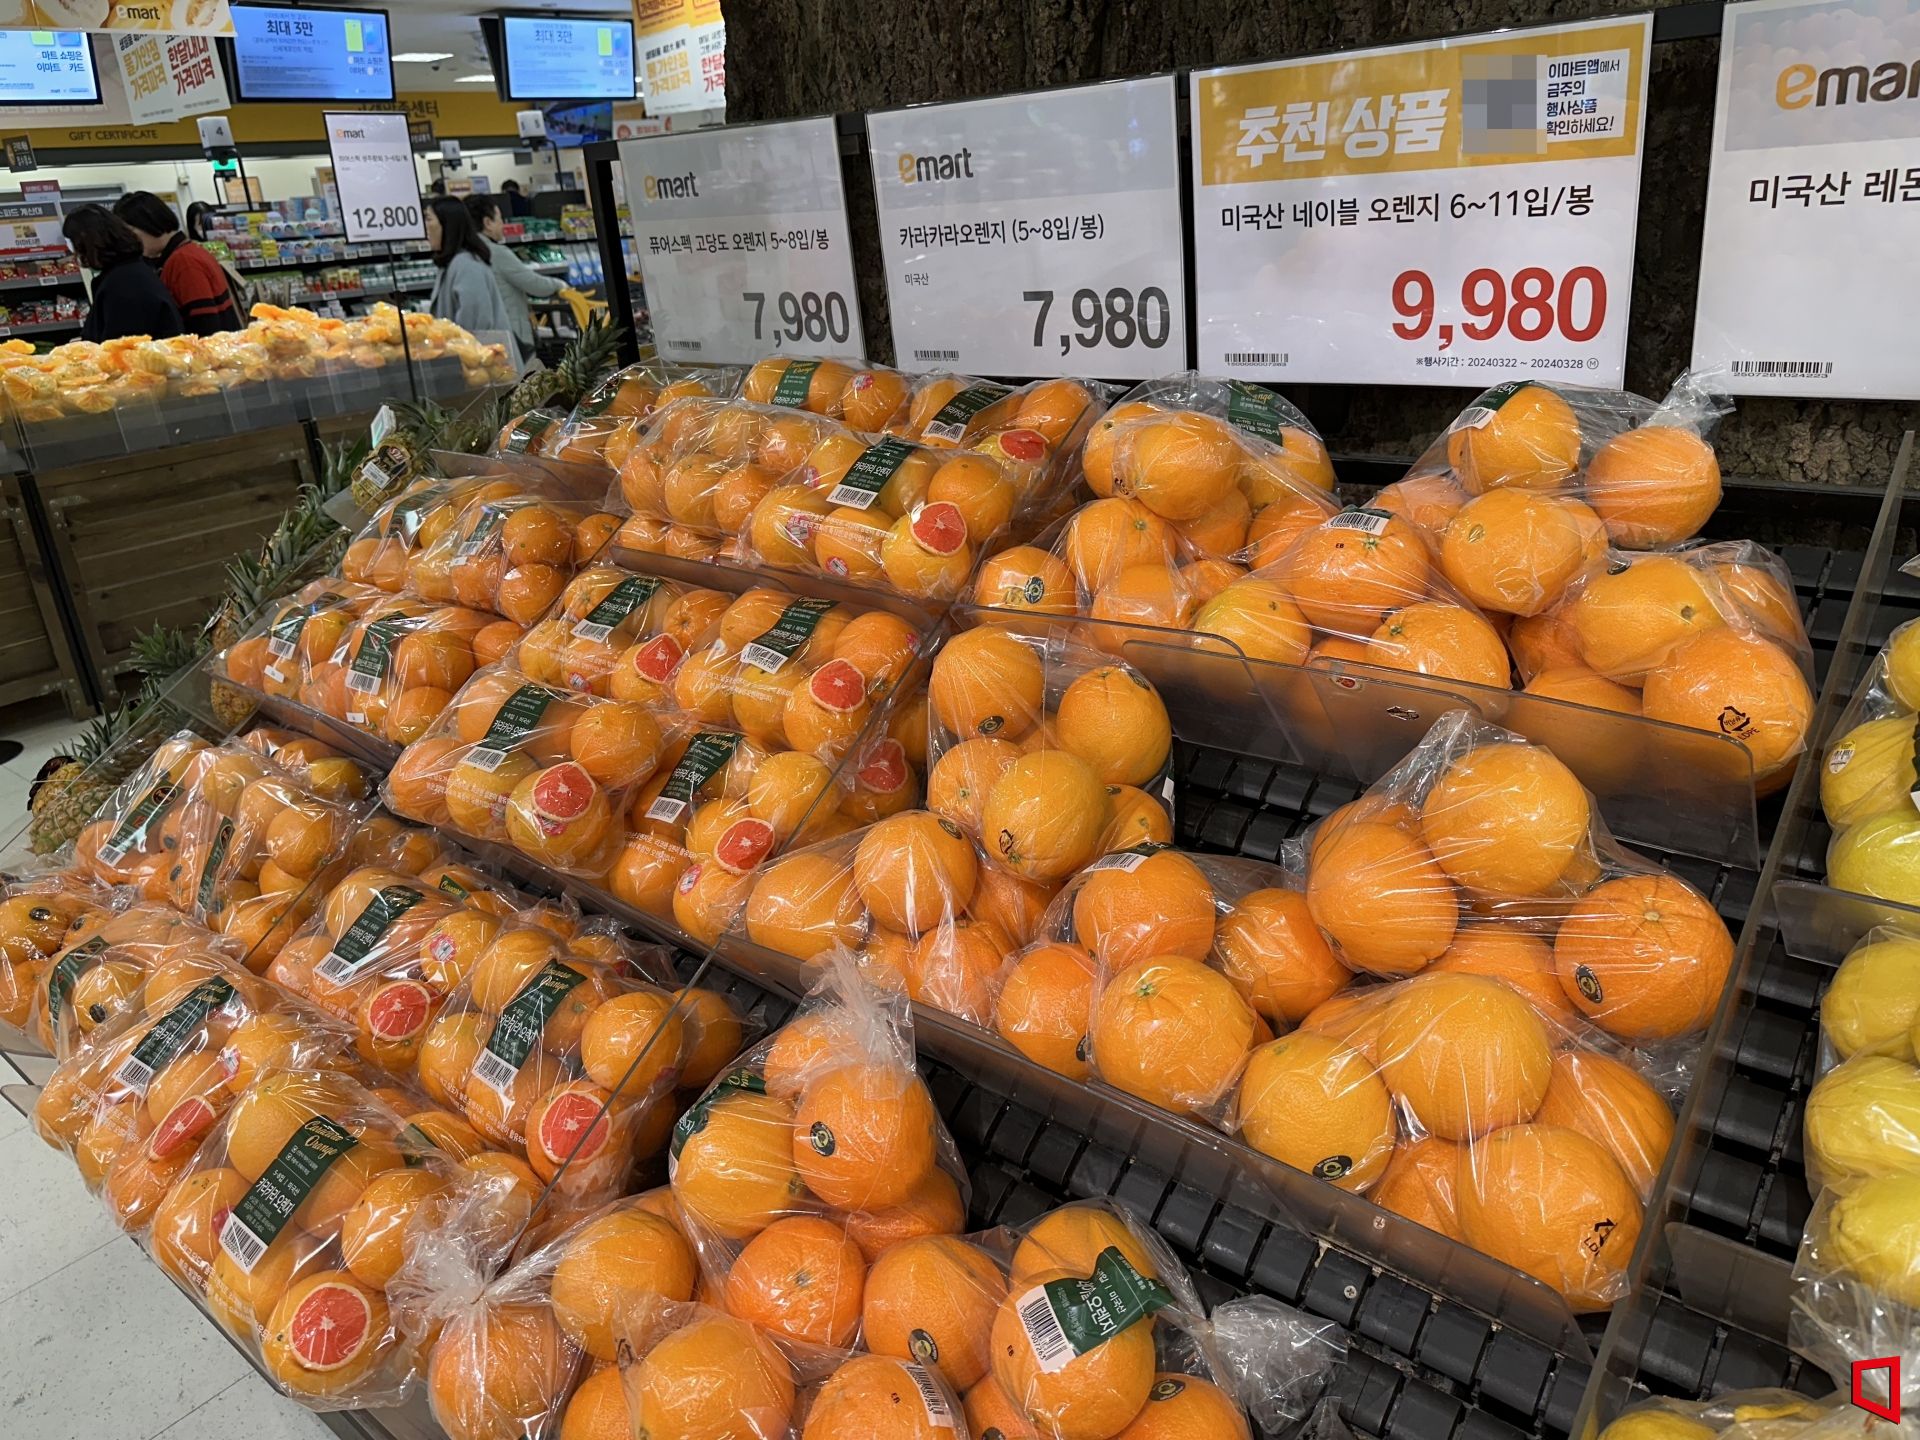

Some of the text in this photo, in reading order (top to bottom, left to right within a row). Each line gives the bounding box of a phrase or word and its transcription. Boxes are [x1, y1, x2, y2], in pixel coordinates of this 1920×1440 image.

[267, 20, 314, 37] 최대 3만
[36, 62, 85, 72] 이마트 카드
[173, 55, 216, 96] 가격파격
[1548, 58, 1621, 79] 이마트앱에서
[130, 62, 168, 101] 가격파격
[1547, 79, 1586, 98] 금주의
[1546, 98, 1598, 118] 행사상품
[69, 129, 159, 141] GIFT CERTIFICATE
[215, 126, 224, 136] 4
[336, 129, 365, 139] emart
[1237, 88, 1450, 168] 추천 상품
[1545, 116, 1614, 136] 확인하세요!
[899, 147, 974, 184] emart
[644, 171, 699, 199] emart
[1749, 170, 1852, 209] 미국산
[352, 206, 419, 231] 12,800
[1222, 184, 1595, 232] 미국산 네이블 오렌지 6~11입/봉
[649, 228, 830, 255] 퓨어스펙 고당도 오렌지 5~8입/봉
[900, 213, 1106, 248] 카라카라오렌지 (5~8입/봉)
[904, 272, 929, 286] 미국산
[743, 291, 850, 348] 7,980
[1023, 286, 1171, 356] 7,980
[1391, 265, 1608, 351] 9,980
[1467, 358, 1518, 369] 20240322
[1530, 358, 1584, 369] 20240328
[304, 1135, 338, 1159] Orange
[256, 1177, 280, 1207] 카라카라
[273, 1193, 296, 1218] 오렌지
[1086, 1295, 1118, 1336] 오렌지
[1109, 1291, 1127, 1315] 미국산
